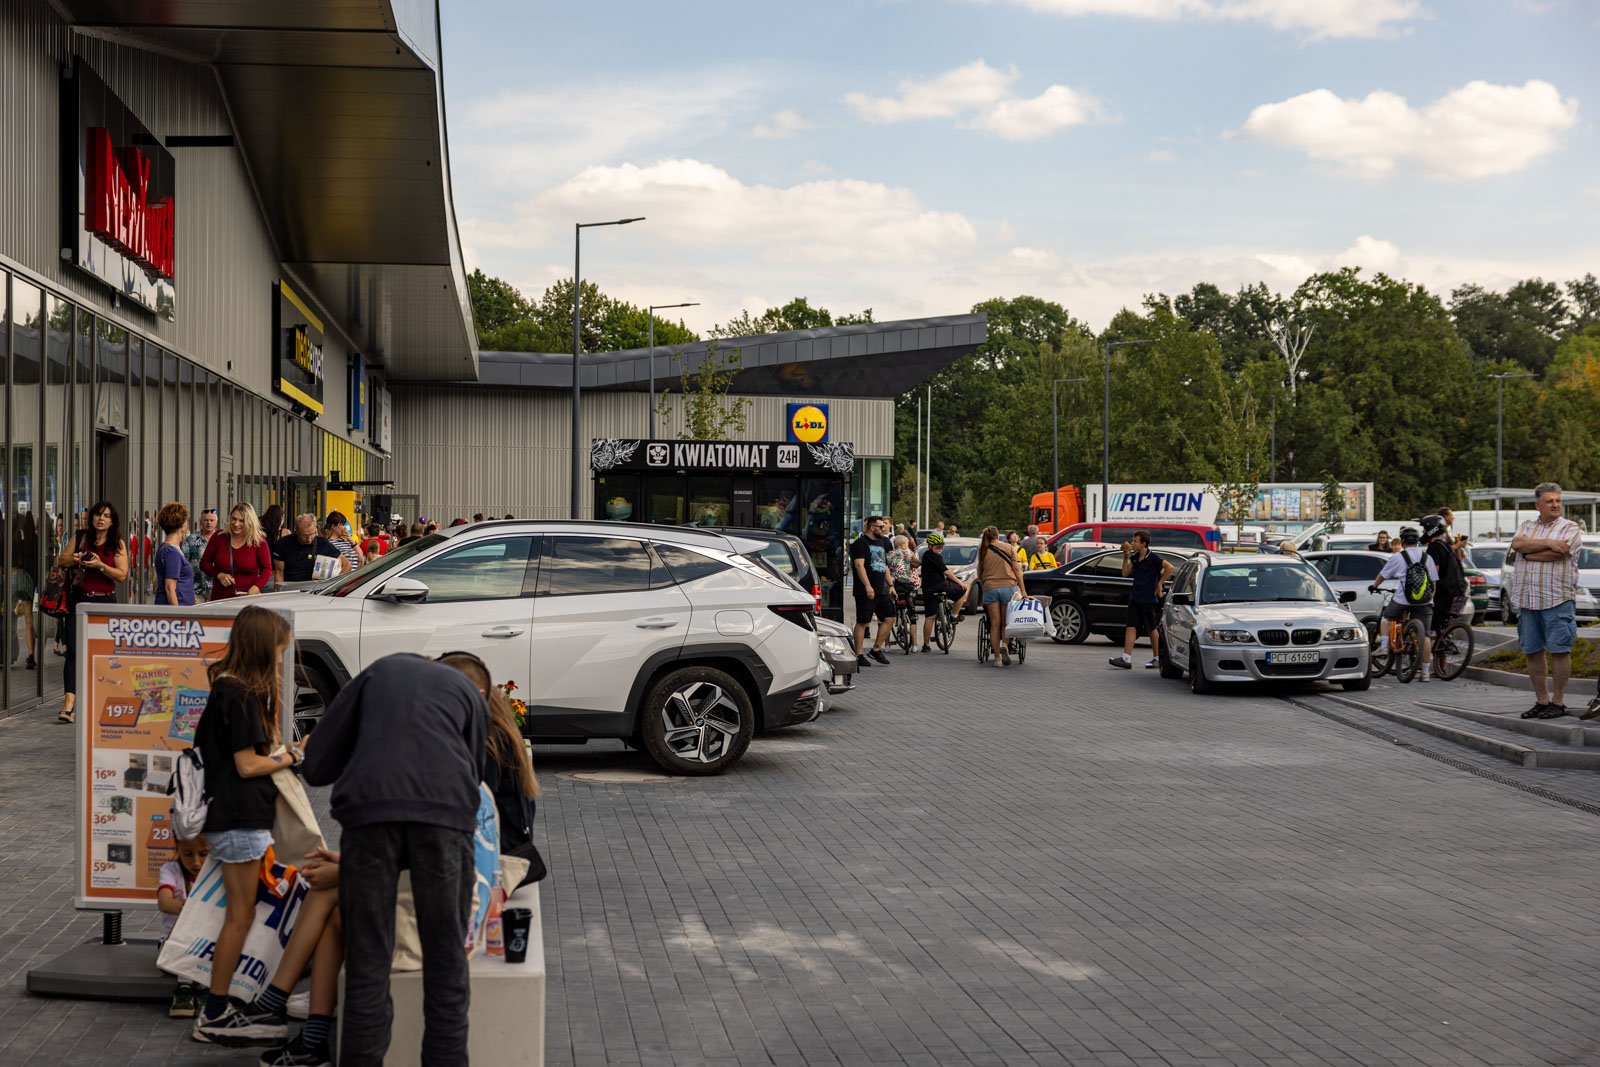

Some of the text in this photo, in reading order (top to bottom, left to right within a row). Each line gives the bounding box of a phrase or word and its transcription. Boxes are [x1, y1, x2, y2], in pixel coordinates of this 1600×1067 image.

[674, 443, 798, 468] KWIATOMAT 24H
[1120, 493, 1203, 511] ACTION
[109, 618, 203, 635] PROMOCJA
[112, 632, 201, 649] TYGODNIA
[1271, 652, 1318, 662] PCT 6169C
[135, 670, 168, 680] HARIBO
[106, 705, 134, 717] 1975
[95, 769, 116, 779] 1699
[94, 814, 116, 824] 3699
[199, 941, 269, 988] ATION
